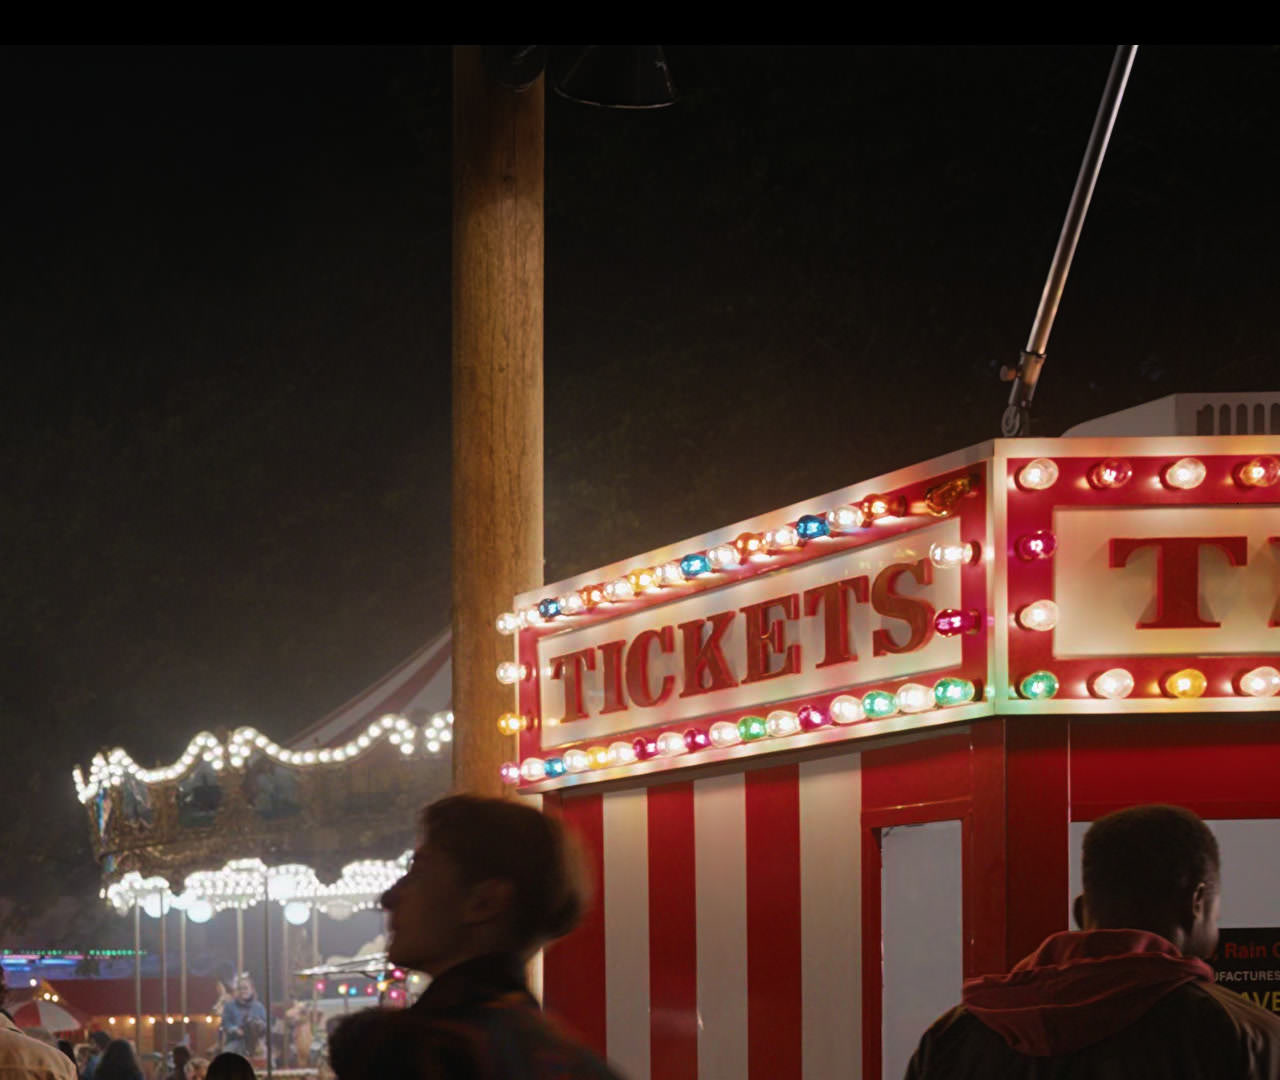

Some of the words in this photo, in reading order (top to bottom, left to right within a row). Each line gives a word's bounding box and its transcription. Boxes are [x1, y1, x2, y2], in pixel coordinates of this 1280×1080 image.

[1109, 536, 1280, 629] T
[550, 558, 935, 724] TICKETS
[1224, 942, 1267, 960] Rain
